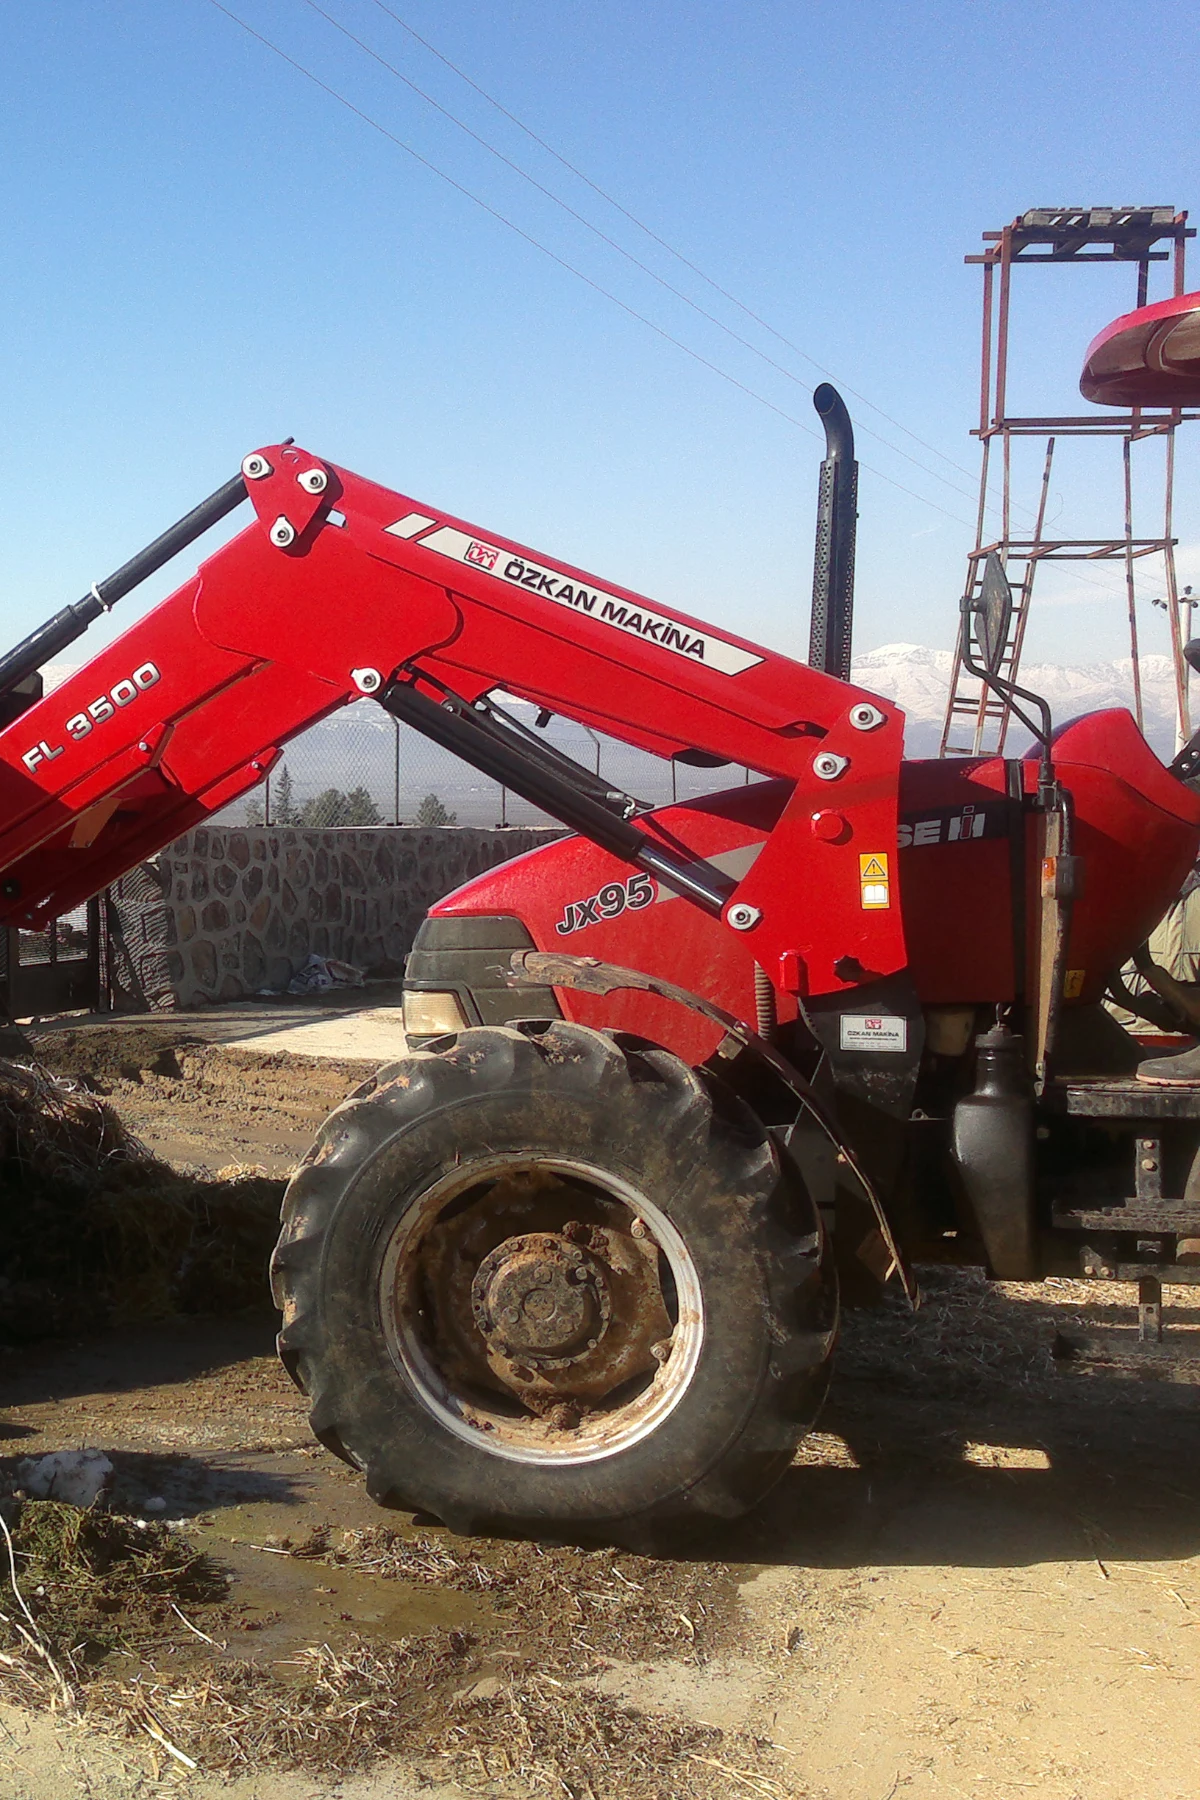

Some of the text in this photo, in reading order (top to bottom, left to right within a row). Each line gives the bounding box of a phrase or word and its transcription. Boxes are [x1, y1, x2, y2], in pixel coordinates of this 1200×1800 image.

[503, 559, 705, 661] ÖZKAN MAKİNA
[21, 661, 161, 774] FL 3500
[555, 872, 655, 936] JX95
